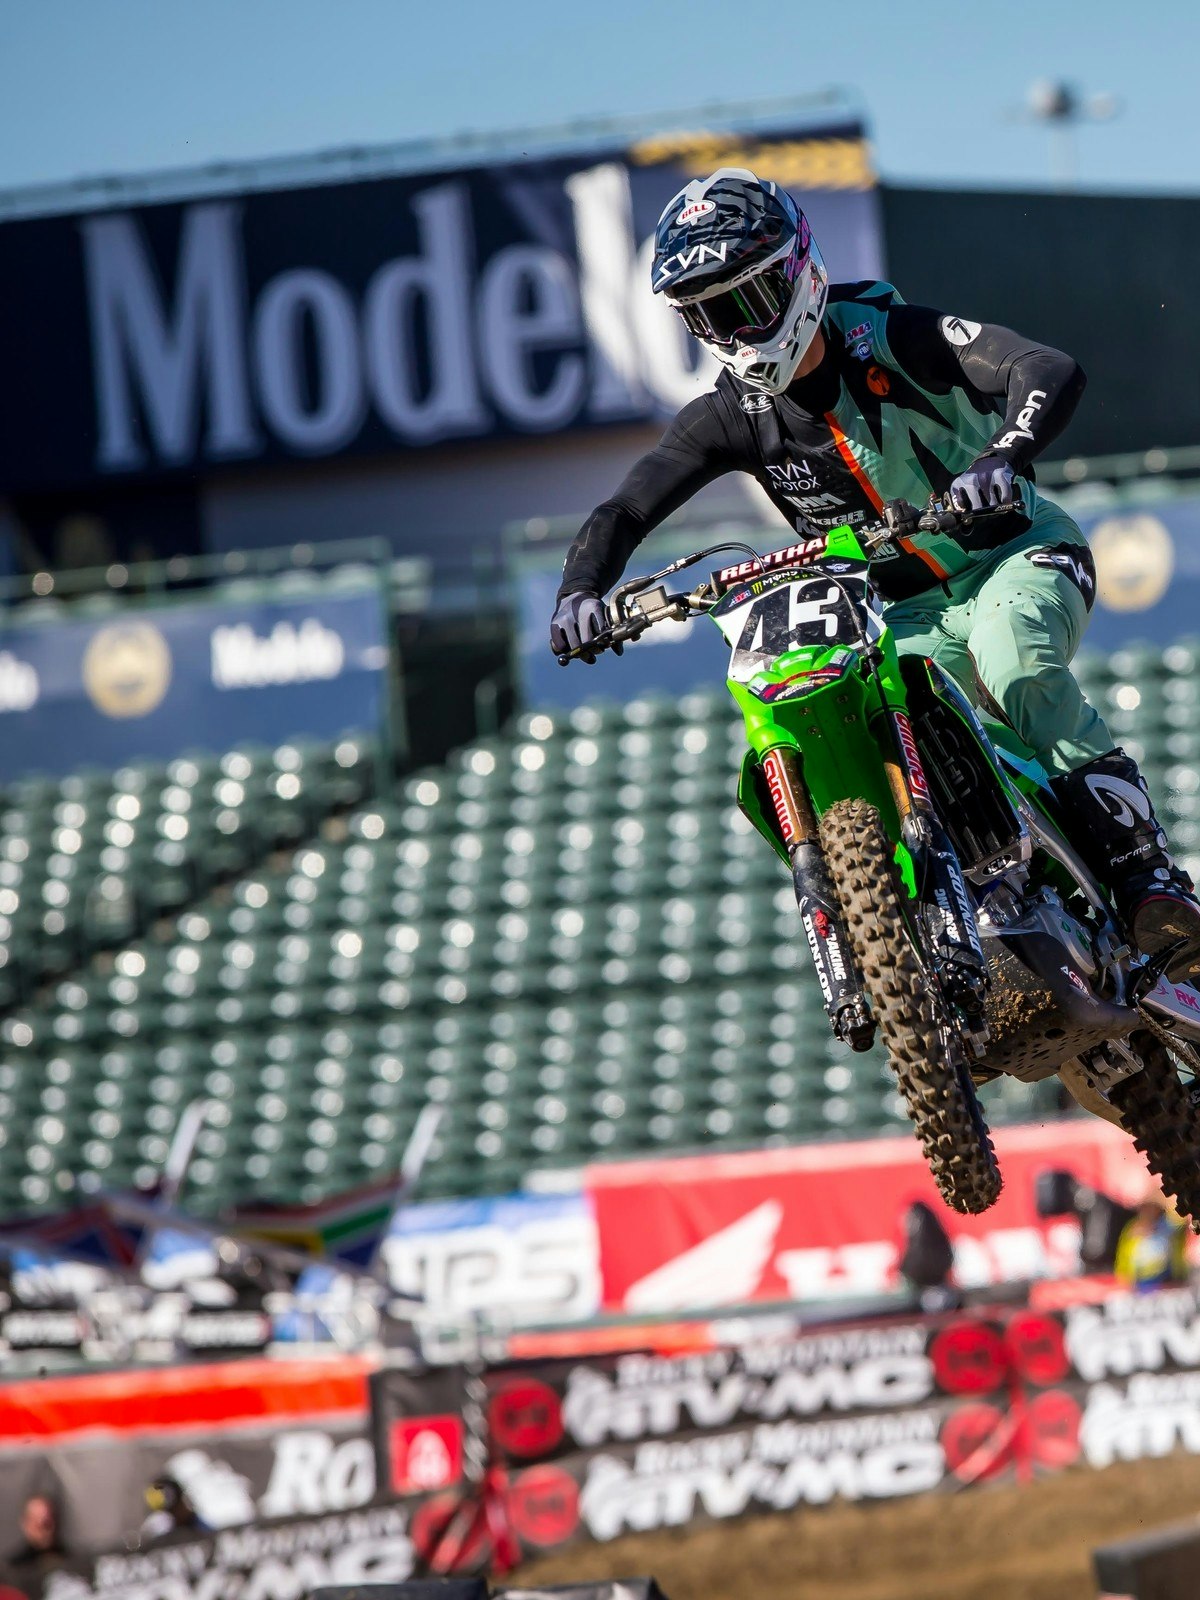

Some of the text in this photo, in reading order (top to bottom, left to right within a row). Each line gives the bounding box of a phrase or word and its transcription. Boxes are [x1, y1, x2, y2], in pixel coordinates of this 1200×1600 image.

[681, 203, 709, 220] BELL
[82, 162, 724, 475] Modelo
[741, 348, 757, 358] BELL
[733, 577, 868, 669] 43
[946, 864, 981, 953] DUNLOP
[802, 913, 833, 1003] DUNLOP
